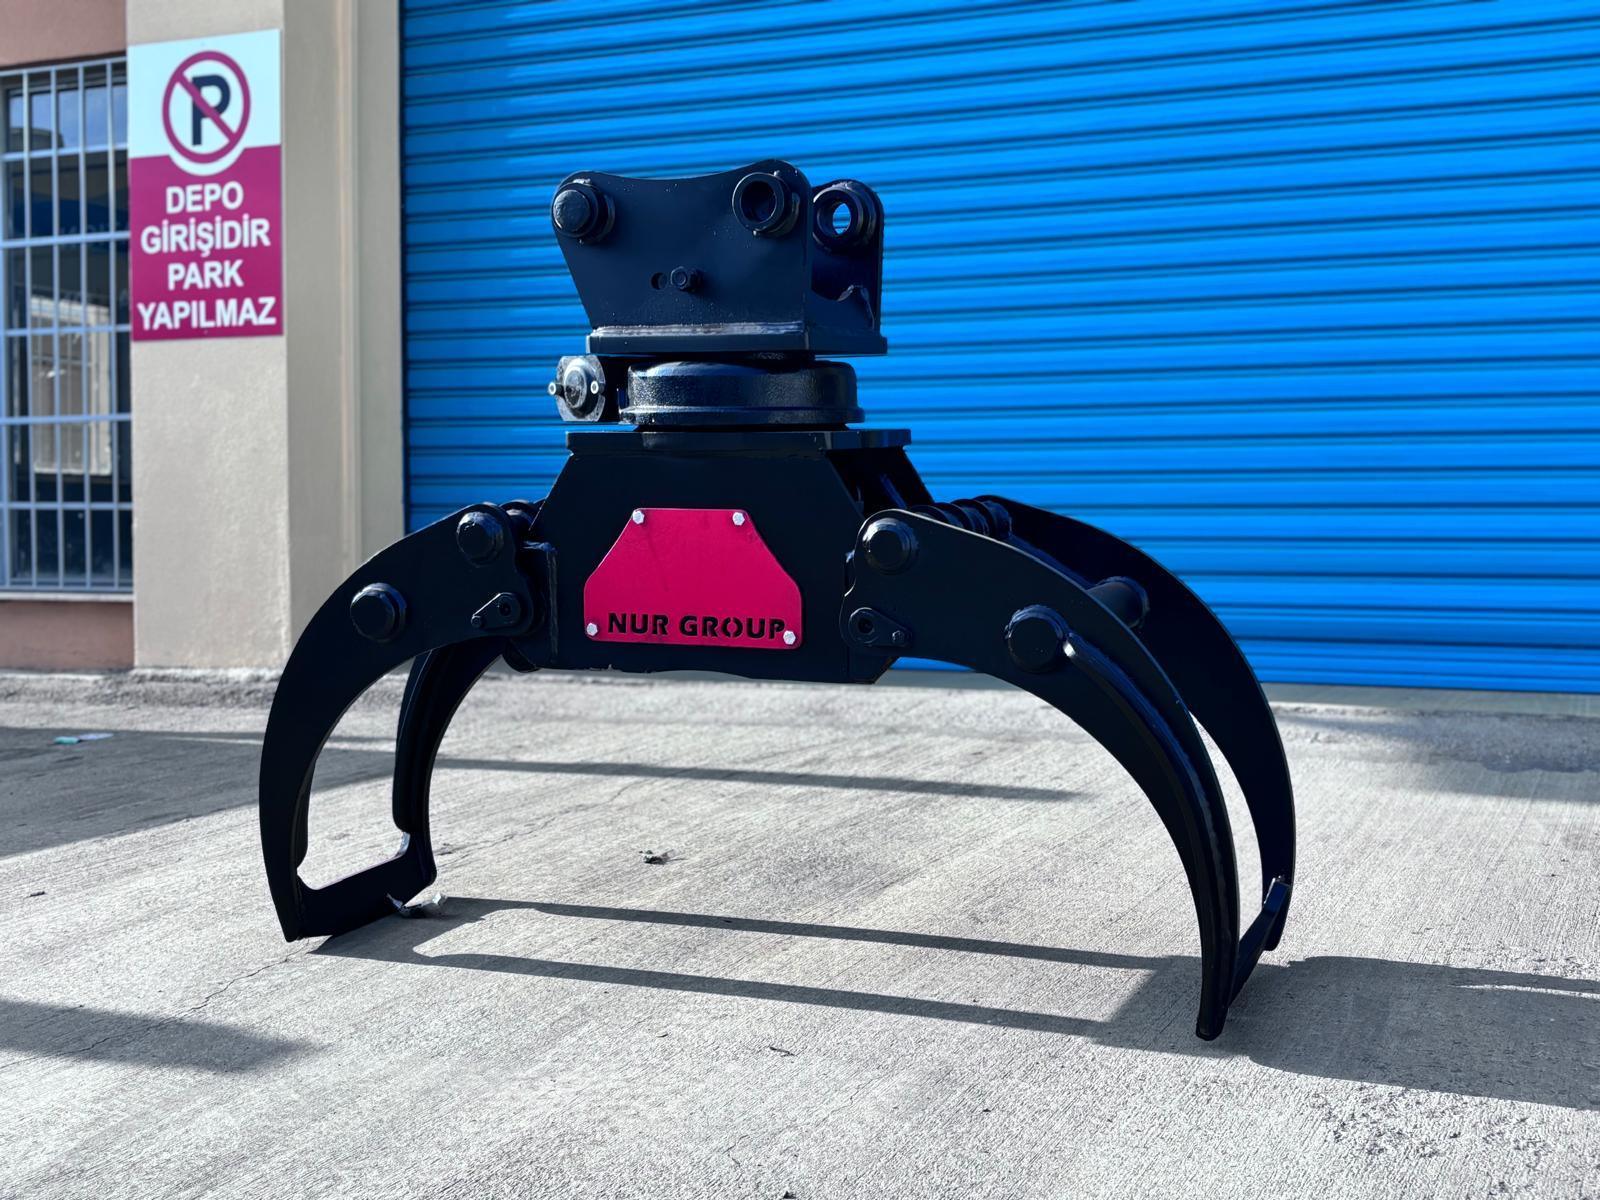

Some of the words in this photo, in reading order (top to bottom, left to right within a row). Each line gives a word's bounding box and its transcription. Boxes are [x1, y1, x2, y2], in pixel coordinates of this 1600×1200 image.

[166, 181, 244, 214] DEPO
[140, 213, 270, 257] GİRİŞİDİR
[168, 259, 244, 291] PARK
[137, 296, 276, 331] YAPILMAZ
[608, 612, 669, 636] NUR
[679, 615, 785, 640] GROUP
